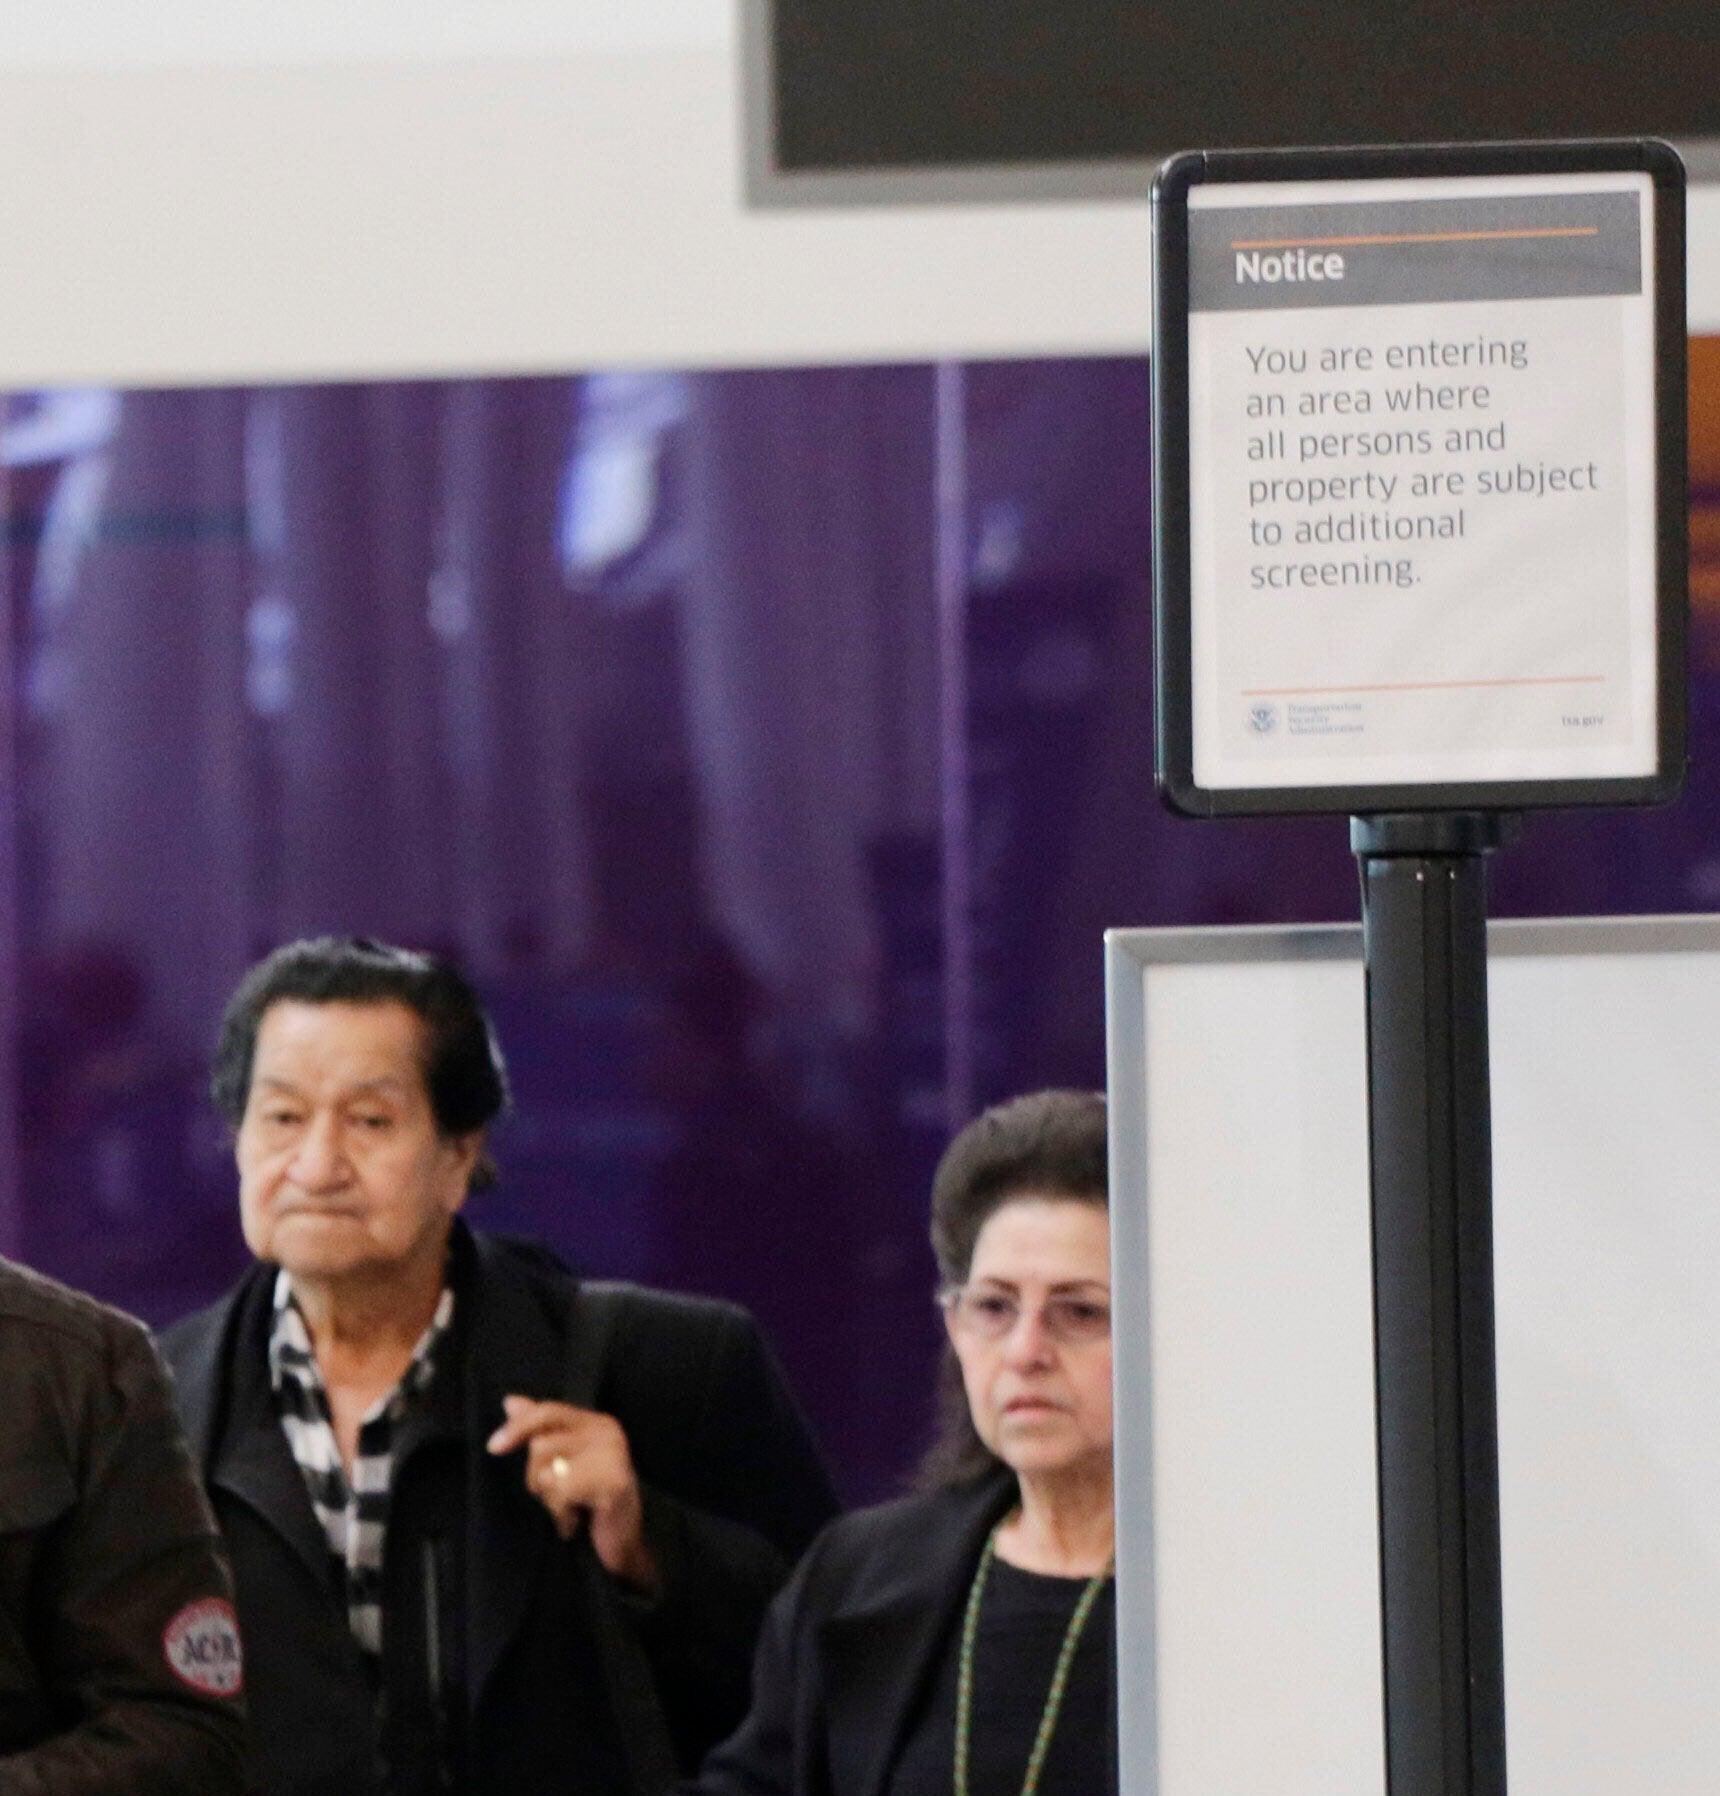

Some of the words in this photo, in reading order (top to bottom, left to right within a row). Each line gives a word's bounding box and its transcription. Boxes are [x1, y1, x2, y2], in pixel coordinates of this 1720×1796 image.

[1235, 248, 1345, 284] Notice
[1245, 345, 1308, 375] You
[1319, 347, 1373, 373] are
[1385, 334, 1530, 370] entering
[1246, 393, 1285, 418] an
[1298, 389, 1372, 416] area
[1385, 380, 1491, 413] where
[1247, 430, 1286, 461] all
[1299, 429, 1433, 464] persons
[1444, 421, 1506, 453] and
[1248, 471, 1398, 508] property
[1410, 472, 1465, 497] are
[1476, 461, 1598, 497] subject
[1249, 518, 1283, 547] to
[1294, 508, 1466, 544] additional
[1249, 553, 1422, 590] screening.
